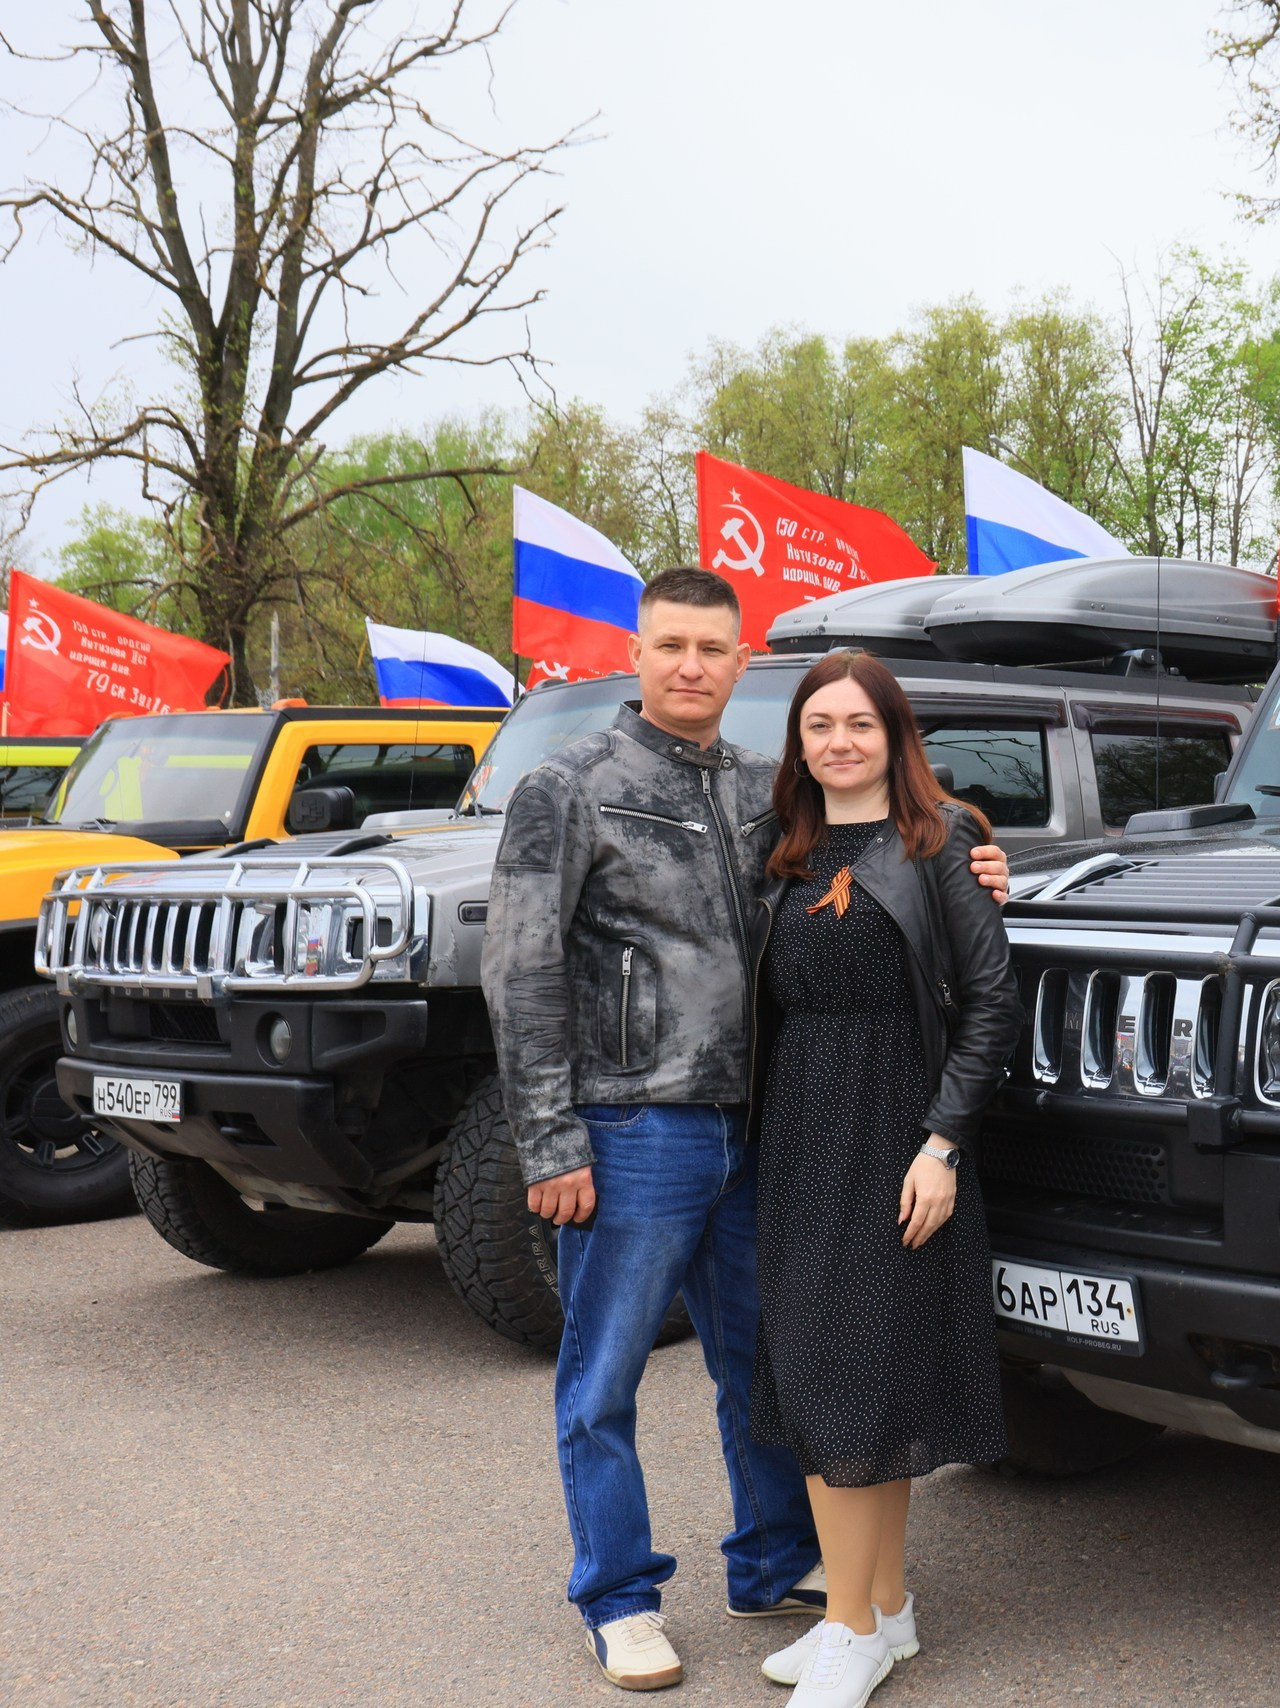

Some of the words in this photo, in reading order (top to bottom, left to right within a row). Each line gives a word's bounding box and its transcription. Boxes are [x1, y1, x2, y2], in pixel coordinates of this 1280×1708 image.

[776, 517, 798, 538] 150
[72, 619, 89, 635] 150
[86, 669, 110, 693] 79
[154, 1083, 177, 1108] 799
[160, 1109, 172, 1118] RUS
[528, 1224, 560, 1297] TERRA
[1066, 1278, 1125, 1321] 134
[1090, 1319, 1120, 1335] RUS
[1066, 1335, 1121, 1351] ROLF-PROBEG.RU
